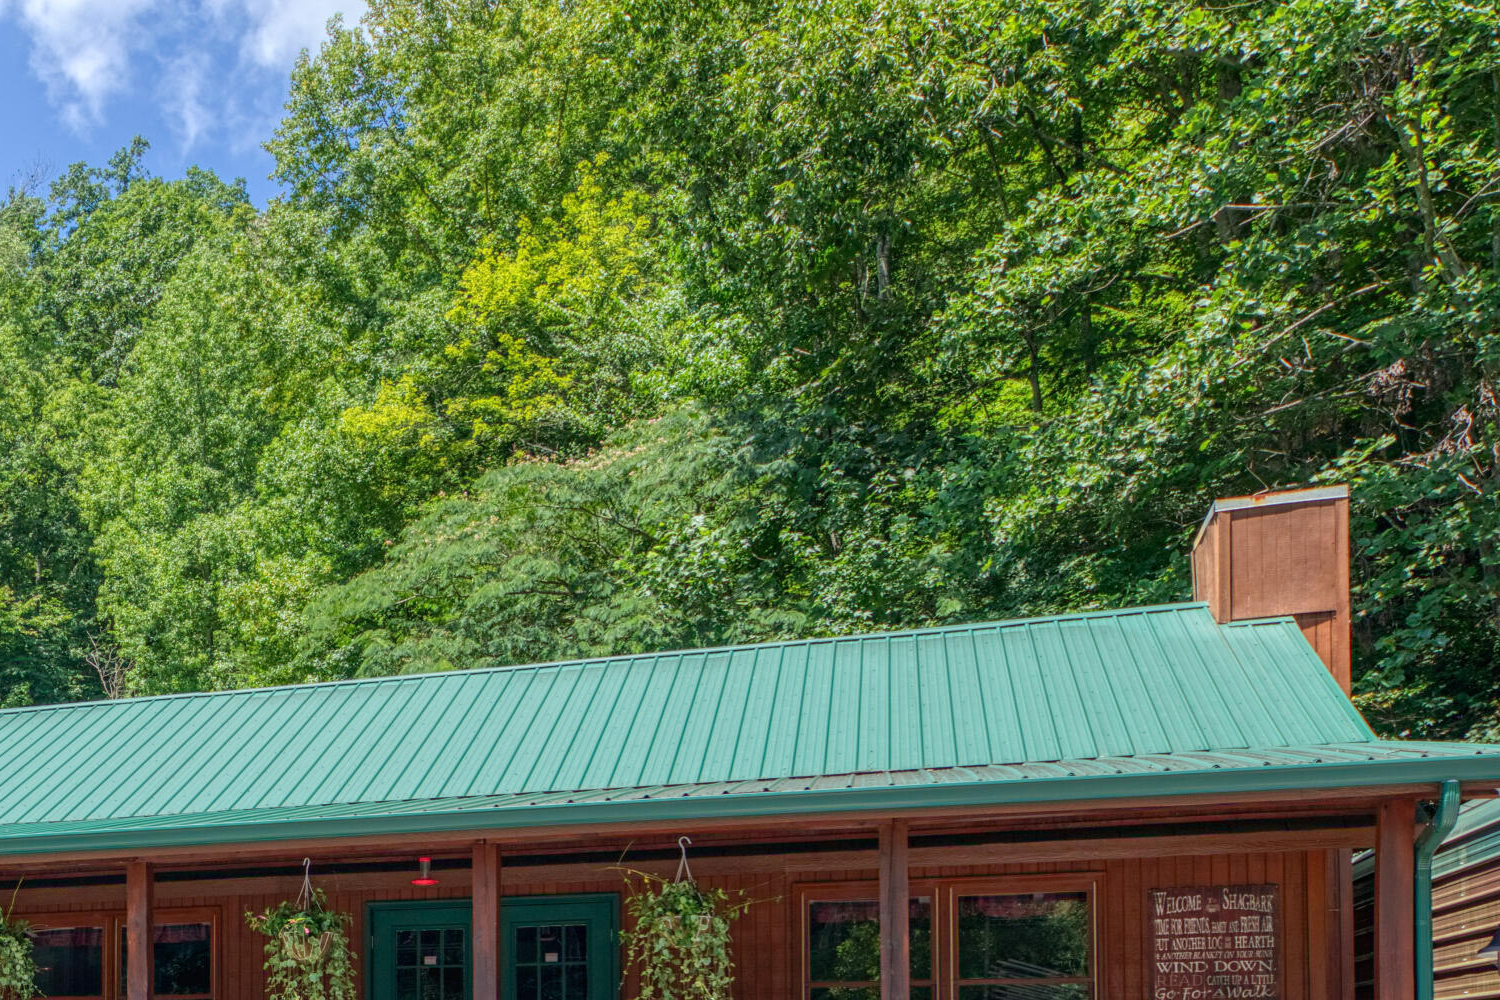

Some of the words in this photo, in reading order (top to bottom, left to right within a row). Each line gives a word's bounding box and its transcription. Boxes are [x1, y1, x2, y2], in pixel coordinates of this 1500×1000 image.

[1222, 888, 1274, 913] SHAGBARK
[1171, 937, 1206, 951] ANOTHER
[1207, 936, 1222, 950] LOG
[1234, 935, 1275, 949] HEARTH
[1156, 961, 1208, 973] WIND
[1206, 975, 1230, 986] CATCH
[1231, 974, 1242, 985] UP
